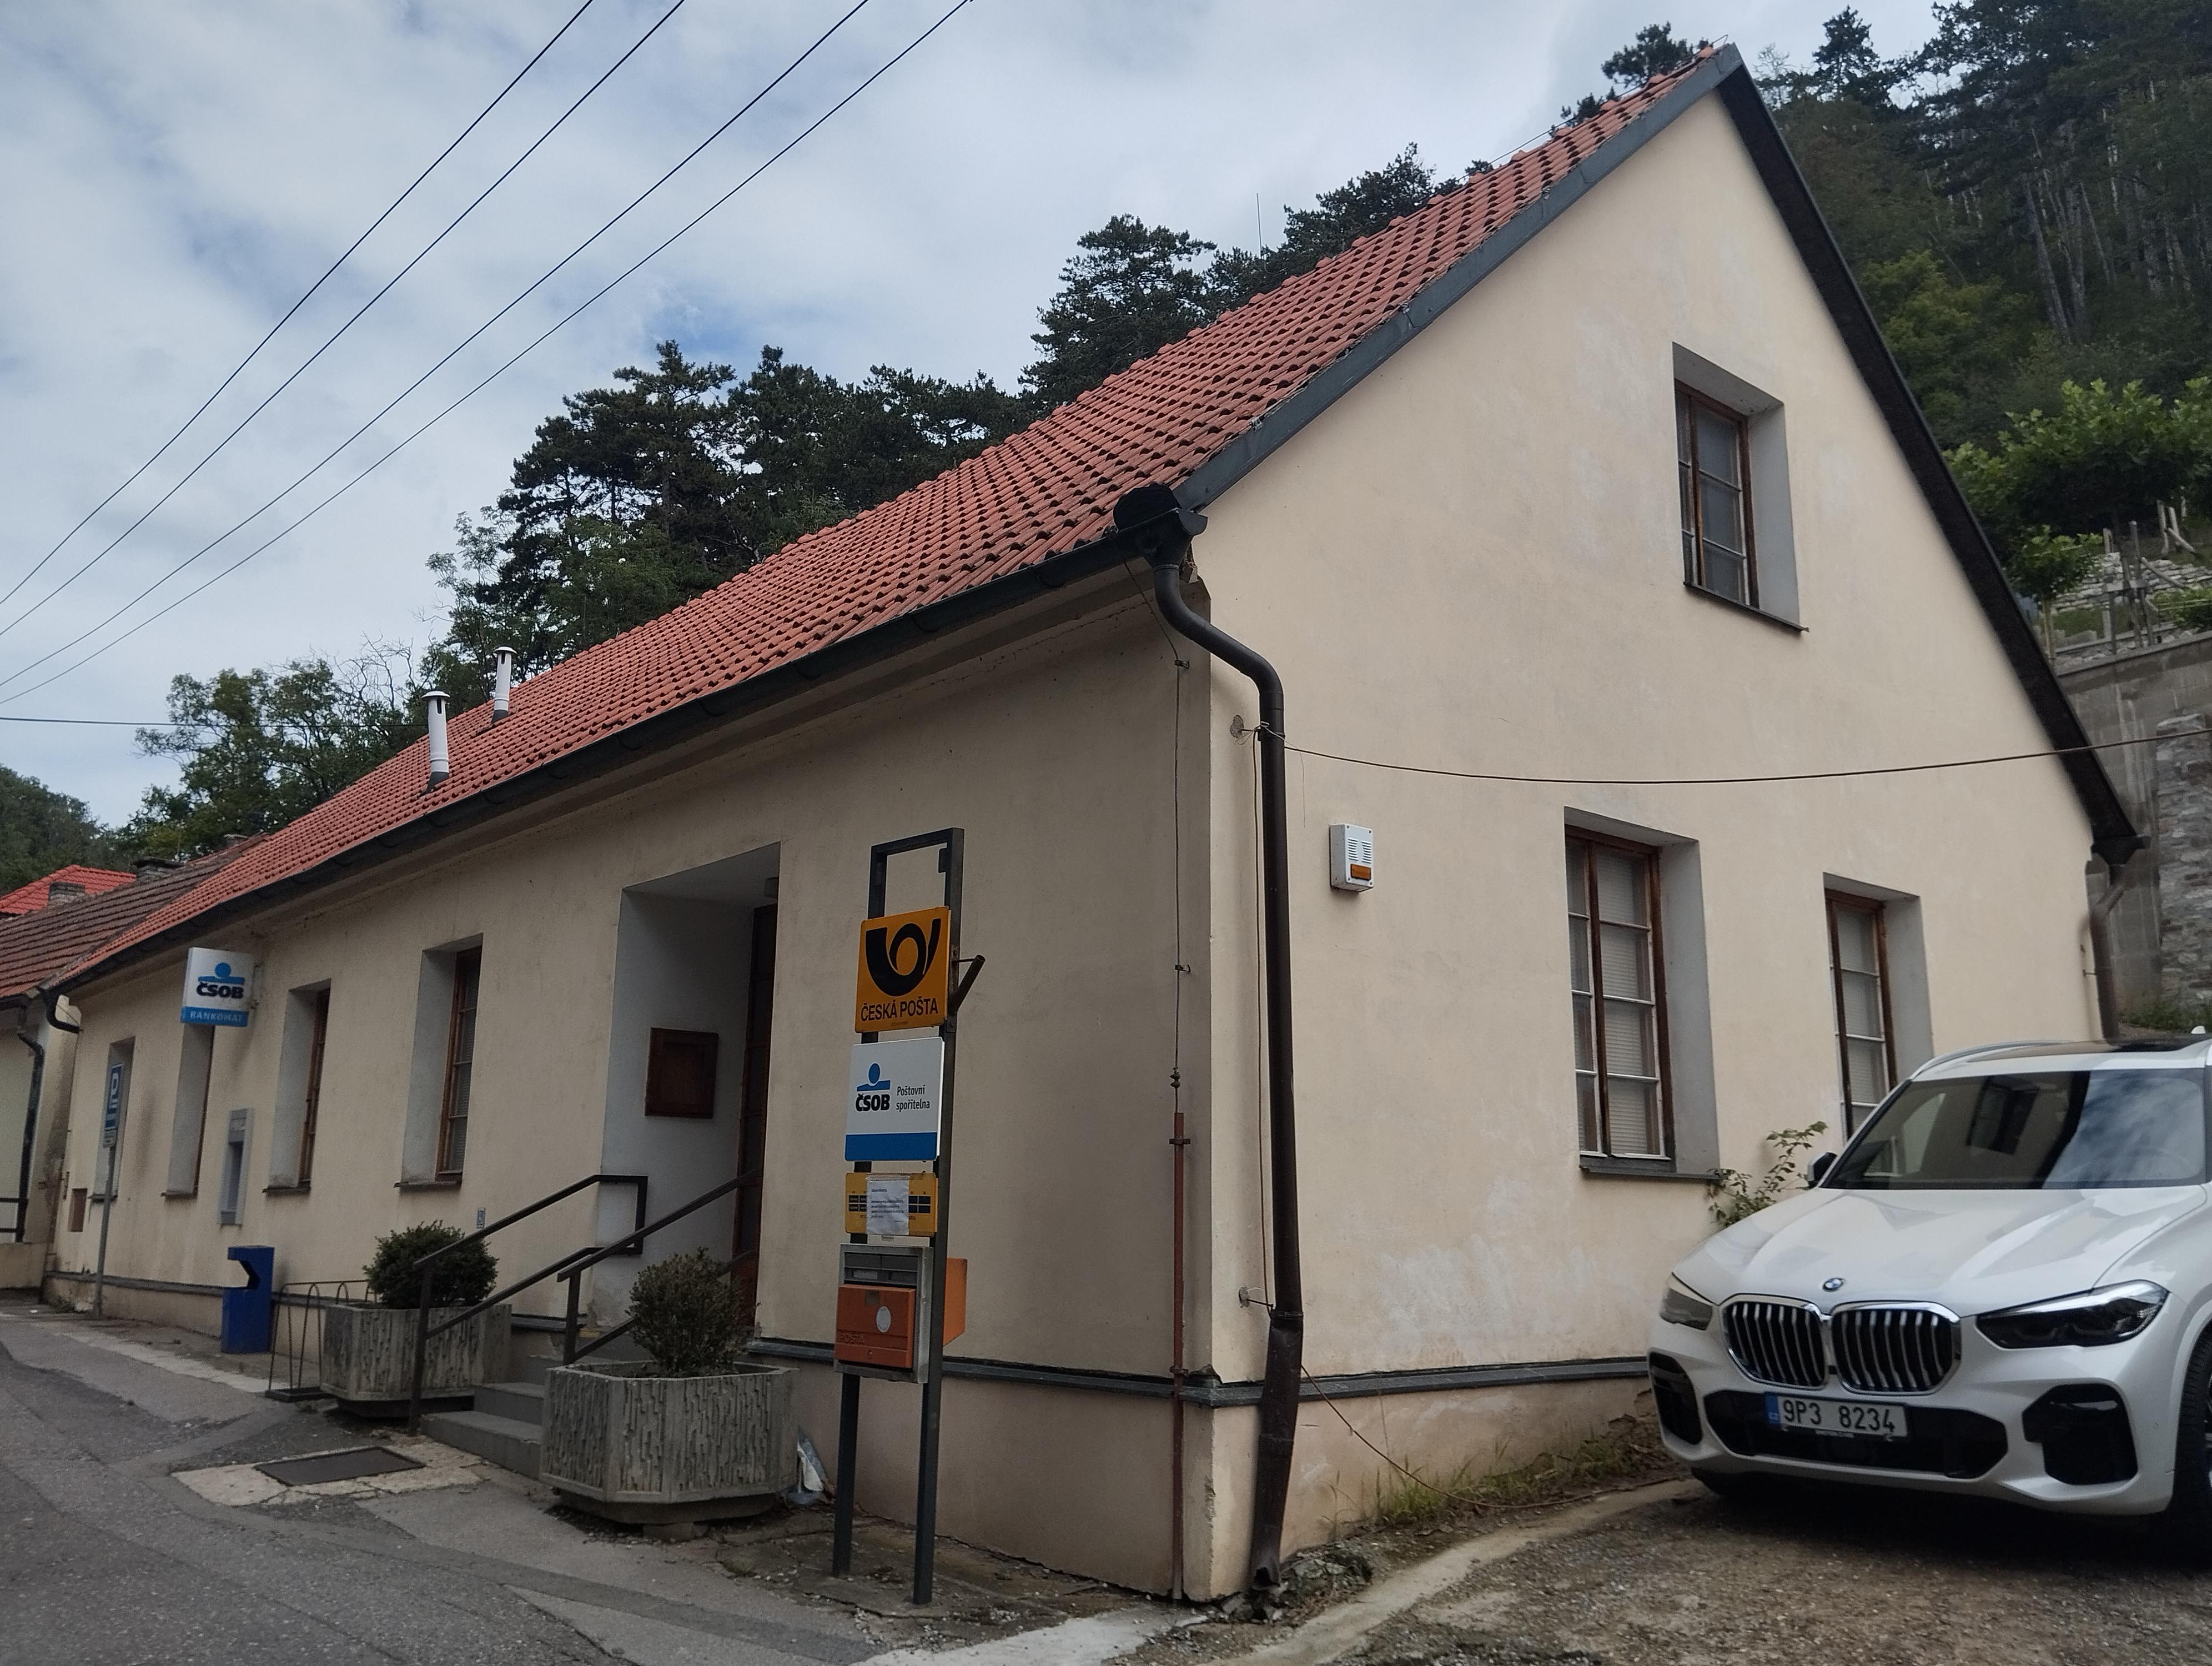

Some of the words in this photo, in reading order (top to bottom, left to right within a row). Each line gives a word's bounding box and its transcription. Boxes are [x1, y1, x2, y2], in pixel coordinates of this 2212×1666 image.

[197, 982, 244, 998] ČSOB
[190, 1011, 242, 1022] BANKOMAT
[861, 1000, 897, 1022] ČESKÁ
[899, 996, 938, 1017] POŠTA
[897, 1085, 926, 1096] Poštovní
[856, 1093, 891, 1112] ČSOB
[896, 1099, 931, 1112] spořitelna
[1783, 1399, 1822, 1426] 9P3
[1838, 1405, 1895, 1433] 8234
